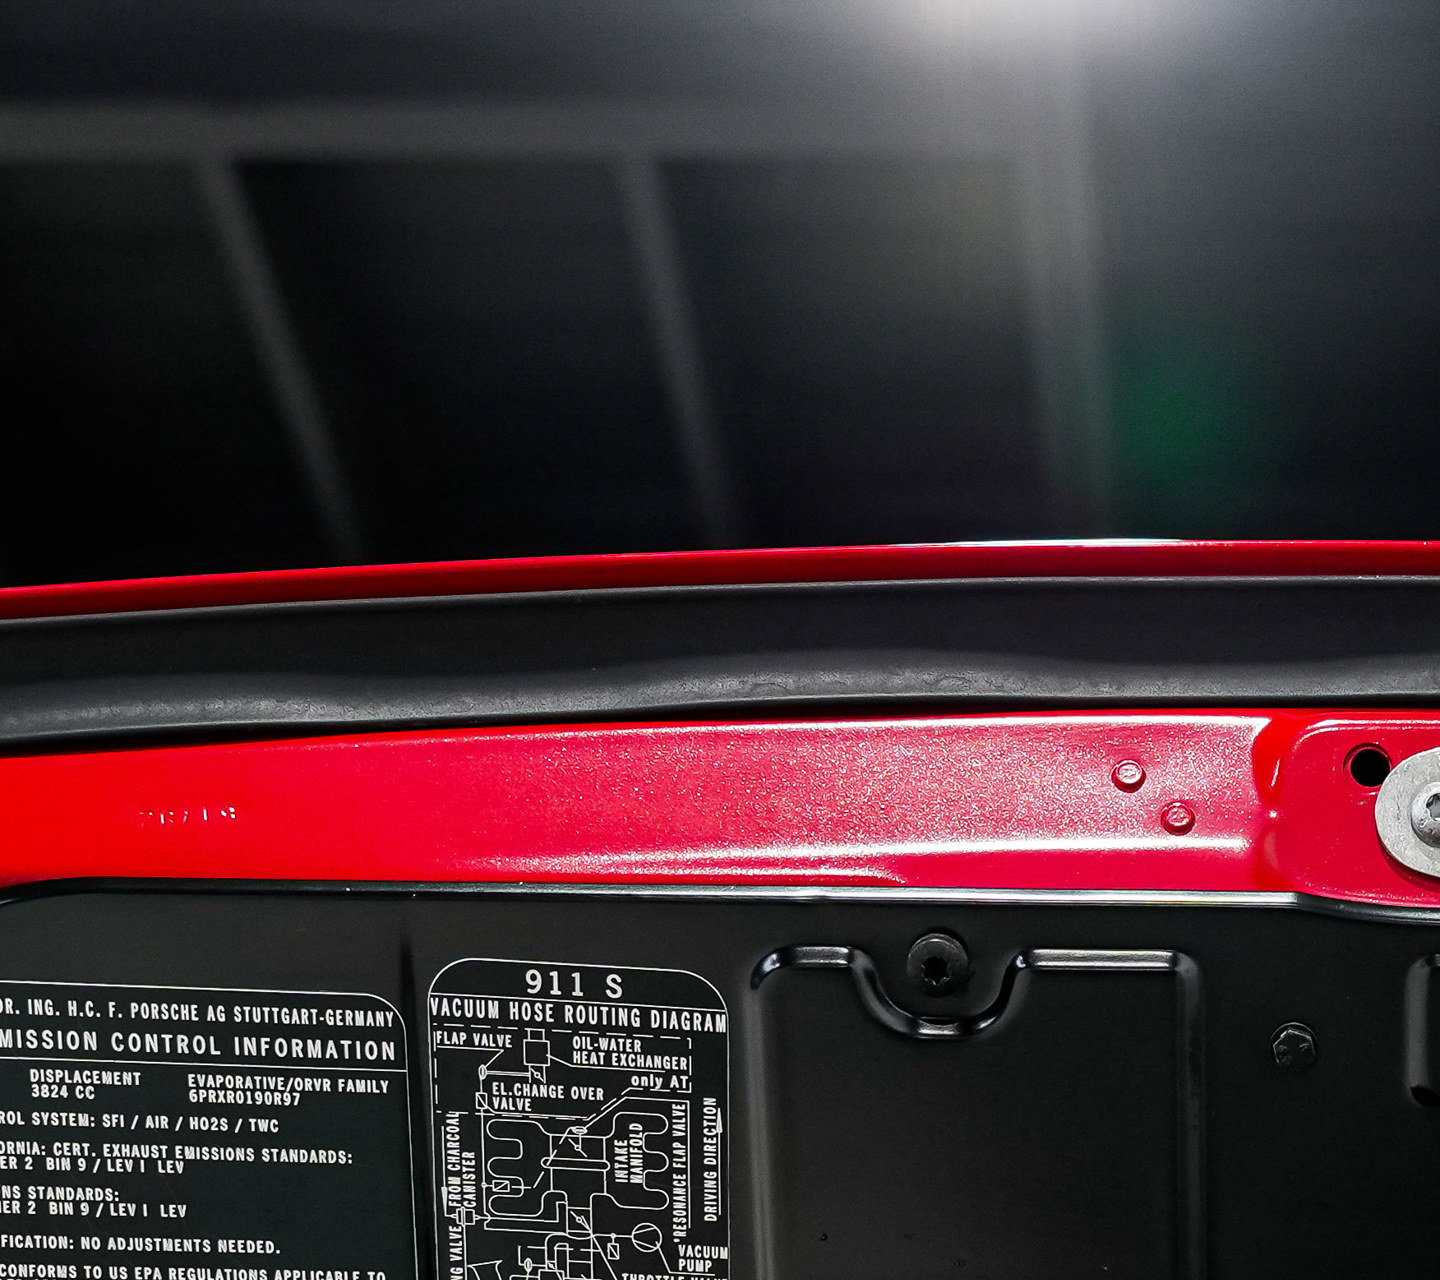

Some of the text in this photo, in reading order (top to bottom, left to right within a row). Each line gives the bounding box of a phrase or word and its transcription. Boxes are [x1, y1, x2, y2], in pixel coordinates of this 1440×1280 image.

[526, 969, 622, 998] 911 S
[28, 999, 60, 1016] ING.
[68, 1000, 101, 1017] H.C.
[108, 1001, 122, 1018] F.
[130, 1002, 199, 1021] PORSCHE
[207, 1005, 225, 1022] AG
[234, 1006, 393, 1027] STUTTGART-GERMANY
[430, 997, 726, 1033] VACUUM HOSE ROUTING DIAGRAM
[111, 1032, 221, 1055] CONTROL
[234, 1037, 394, 1061] INFORMATION
[436, 1031, 512, 1048] FLAP VALVE
[573, 1036, 641, 1052] OIL-WATER
[573, 1051, 688, 1071] HEAT EXCHANGER
[30, 1069, 141, 1085] DISPLACEMENT
[188, 1074, 389, 1094] EVAPORATIVE/ORVR FAMILY
[631, 1076, 689, 1091] only AT
[31, 1084, 95, 1099] 3824 CC
[493, 1082, 603, 1100] EL.CHANGE OVER
[492, 1097, 531, 1111] VALVE
[32, 1112, 95, 1127] SYSTEM:
[102, 1113, 124, 1128] SFI
[145, 1115, 169, 1129] AIR
[248, 1118, 279, 1133] TWC
[672, 1104, 686, 1136] VALVE
[53, 1142, 96, 1157] CERT.
[103, 1143, 168, 1158] EXHAUST
[175, 1145, 254, 1162] EMISSIONS
[262, 1148, 352, 1164] STANDARDS:
[447, 1112, 461, 1207] FROM CHARCOAL
[614, 1140, 628, 1182] INTAKE
[629, 1123, 643, 1183] MANIFOLD
[672, 1142, 686, 1168] FLAP
[703, 1098, 717, 1221] DRIVING DIRECTION
[462, 1152, 476, 1207] CANISTER
[28, 1186, 119, 1201] STANDARDS:
[81, 1236, 101, 1250] NO
[107, 1237, 211, 1253] ADJUSTMENTS
[218, 1239, 280, 1254] NEEDED.
[449, 1226, 462, 1261] VALVE
[678, 1245, 728, 1259] VACUUM
[83, 1265, 102, 1279] TO
[109, 1266, 128, 1280] US
[134, 1267, 162, 1280] EPA
[679, 1259, 712, 1272] PUMP
